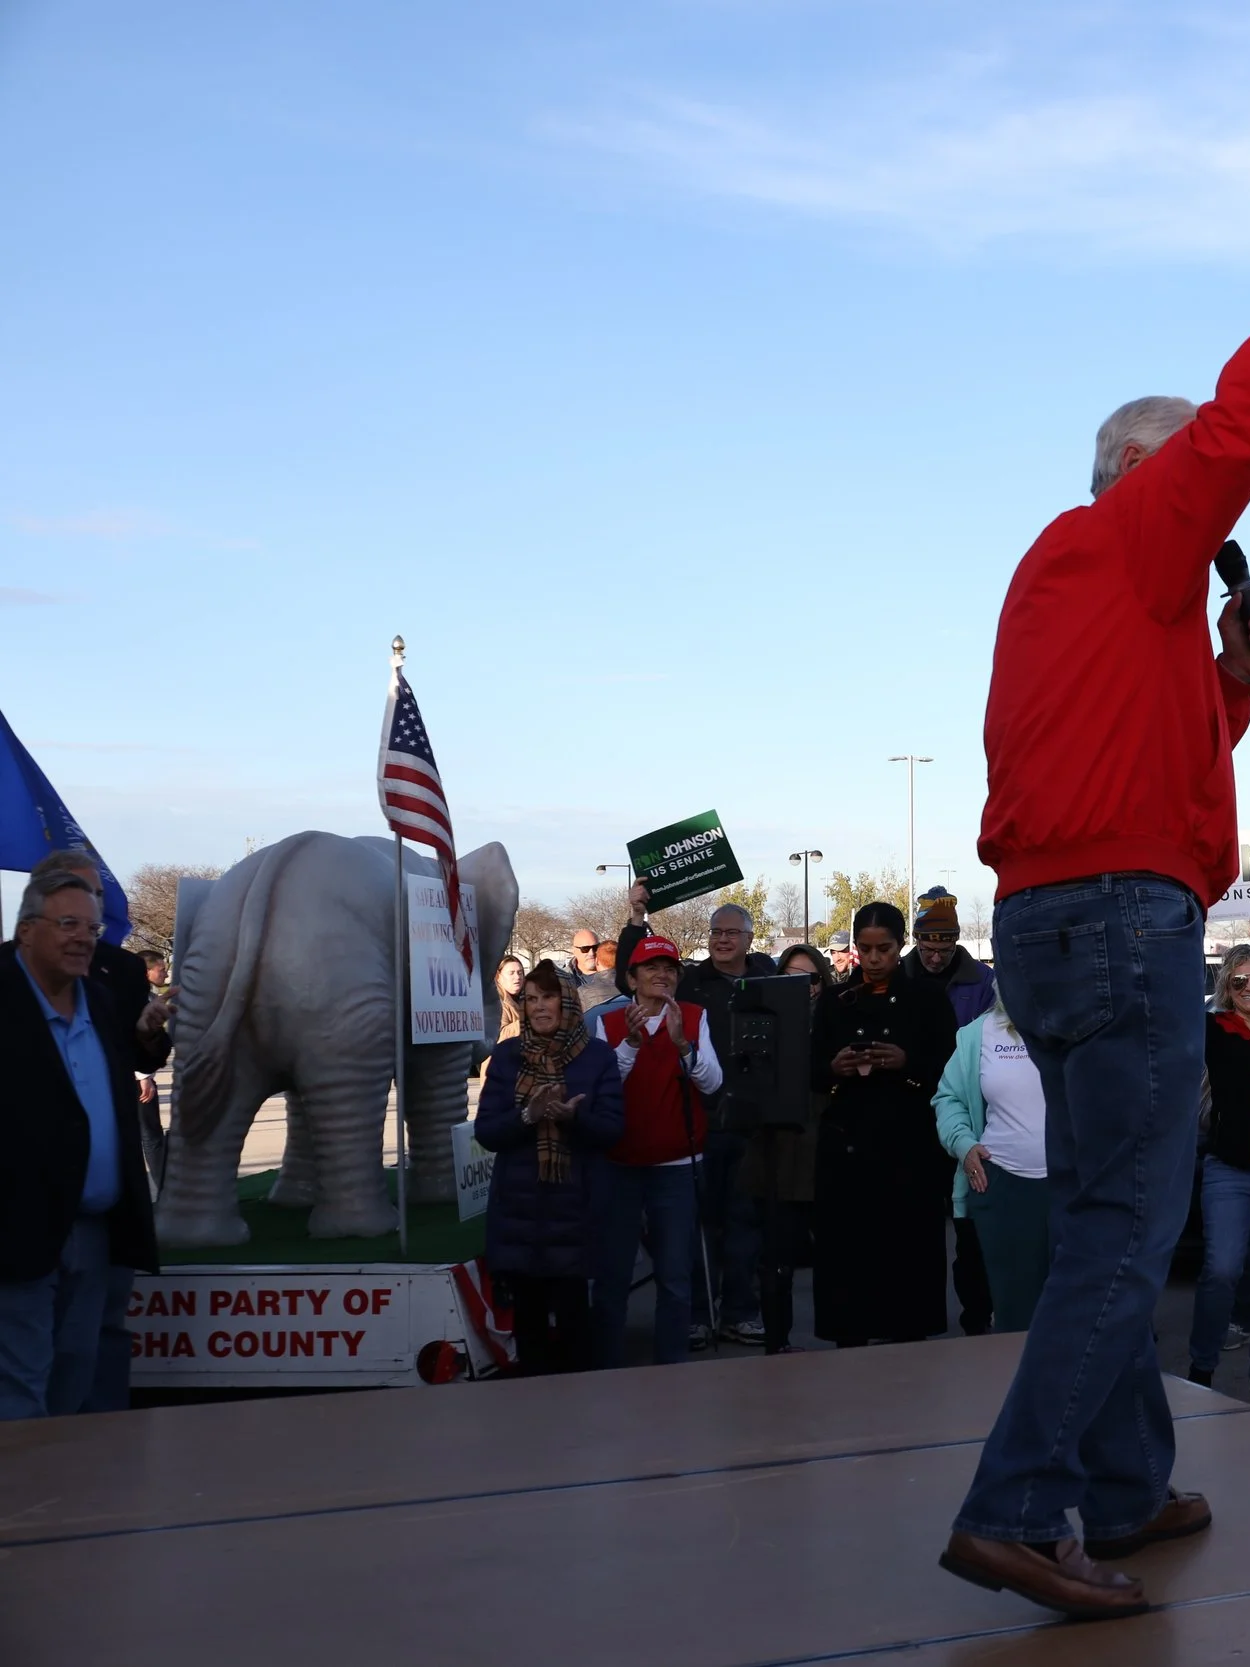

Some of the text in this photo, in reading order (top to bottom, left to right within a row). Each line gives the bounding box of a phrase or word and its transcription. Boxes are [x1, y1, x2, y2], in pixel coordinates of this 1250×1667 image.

[662, 827, 724, 860] JOHNSON
[650, 848, 714, 878] US SENATE
[427, 956, 468, 997] VOTE
[415, 1010, 483, 1034] NOVEMBER 8th
[209, 1289, 331, 1316] PARTY
[342, 1288, 392, 1316] OF
[207, 1330, 366, 1358] COUNTY
